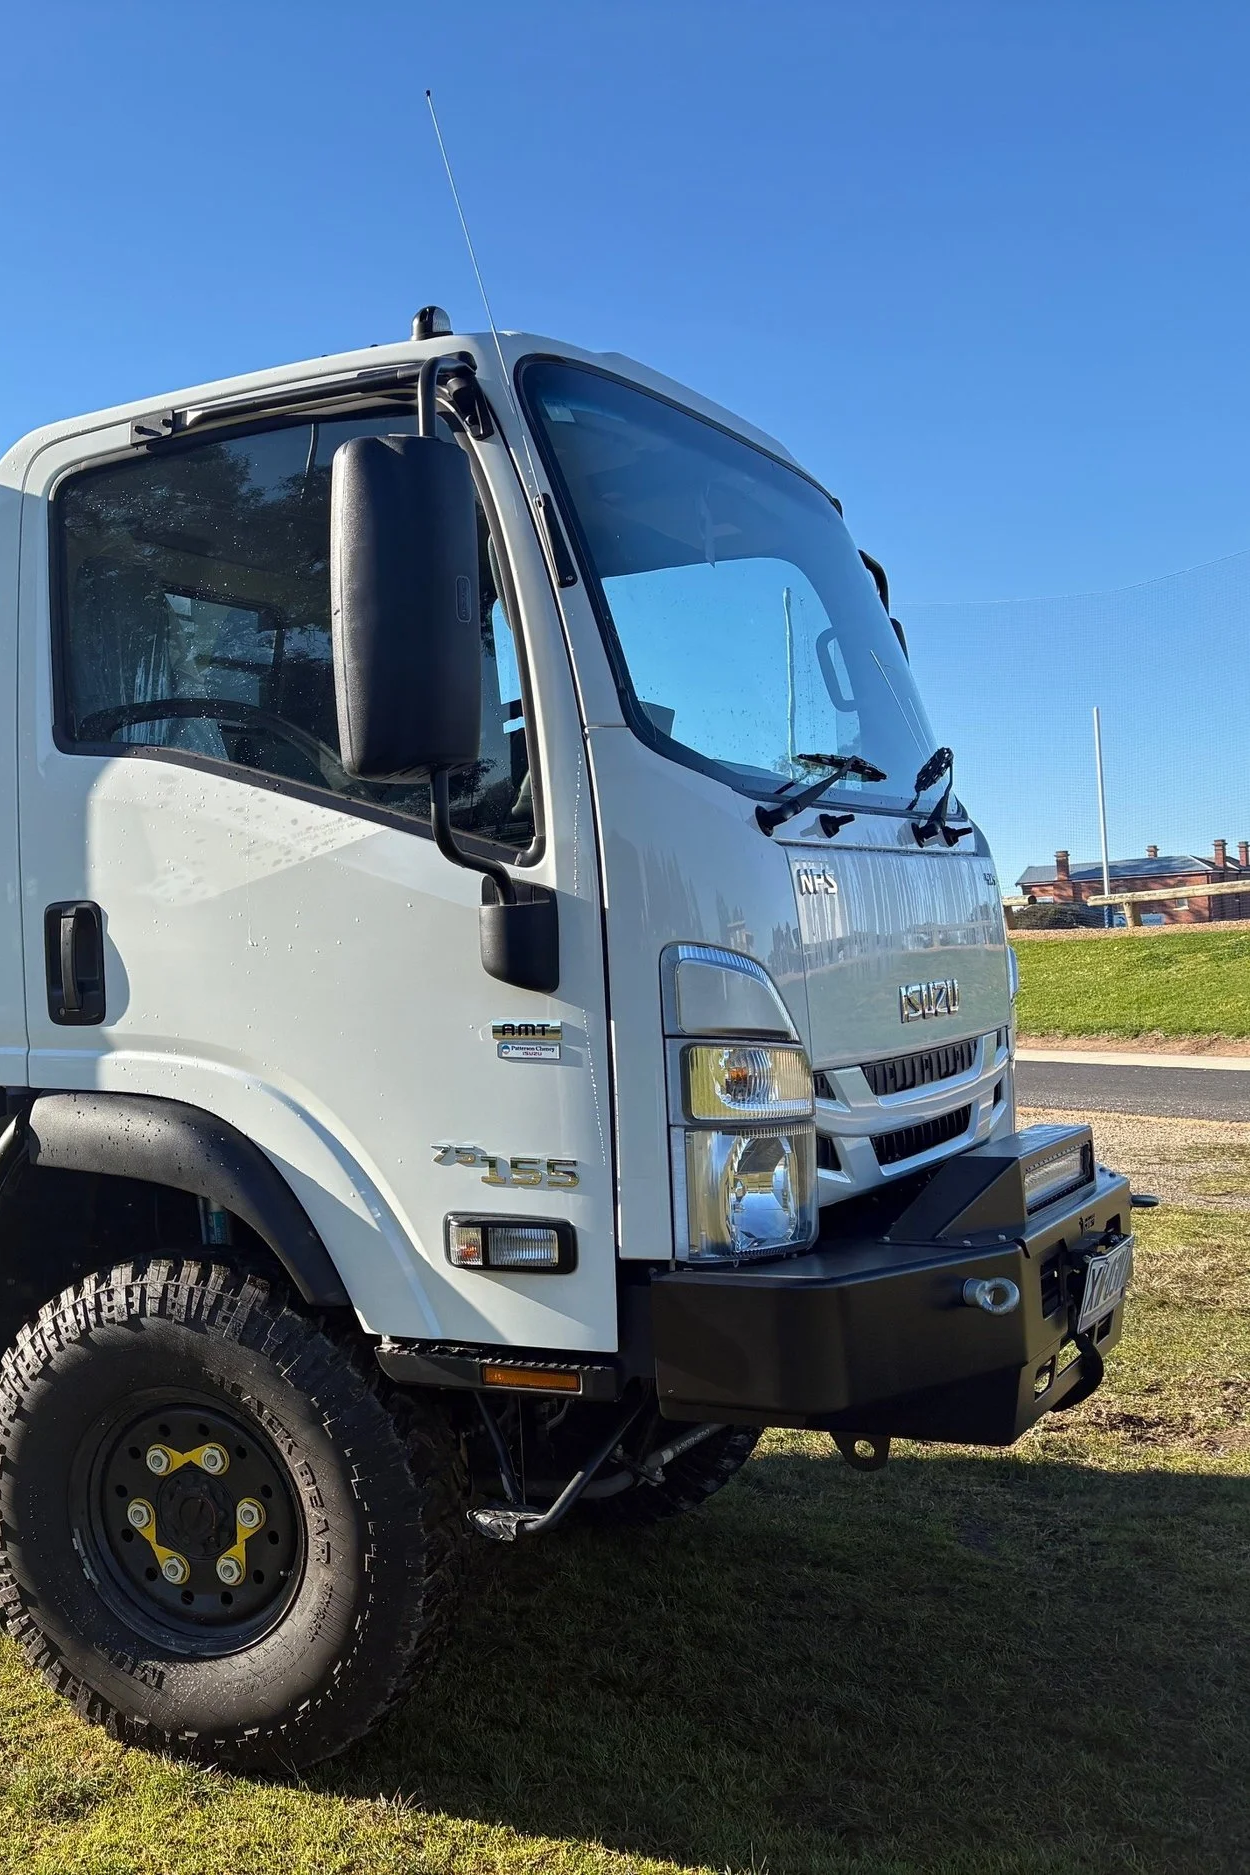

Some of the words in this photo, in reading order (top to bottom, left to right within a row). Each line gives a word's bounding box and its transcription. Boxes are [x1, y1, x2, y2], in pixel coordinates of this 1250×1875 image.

[797, 869, 837, 895] NPS
[899, 979, 959, 1023] ISUZU
[502, 1024, 550, 1036] AMT
[480, 1156, 579, 1187] 155
[295, 1460, 331, 1564] BEAR
